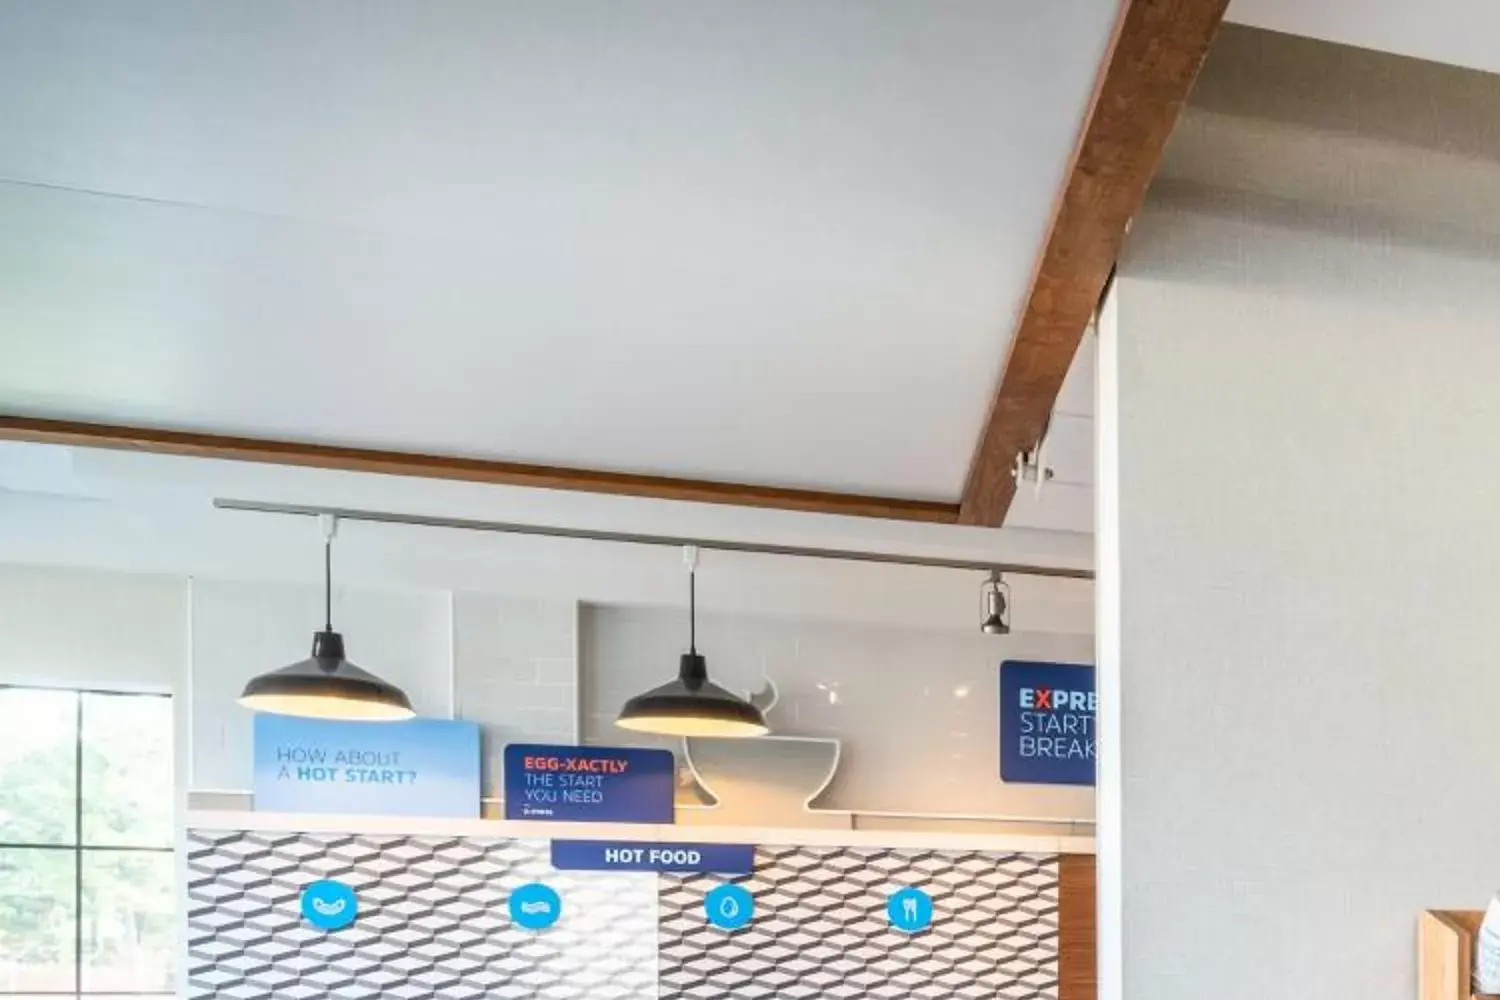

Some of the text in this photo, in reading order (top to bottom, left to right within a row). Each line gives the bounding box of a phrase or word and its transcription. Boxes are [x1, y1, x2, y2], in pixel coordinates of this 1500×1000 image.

[1020, 711, 1092, 735] START
[277, 745, 401, 766] HOW ABOUT
[523, 756, 629, 774] EGG-XACTLY
[277, 764, 418, 785] A HOT START?
[523, 772, 605, 788] THE START
[524, 789, 604, 804] YOU NEED
[604, 847, 702, 865] HOT FOOD
